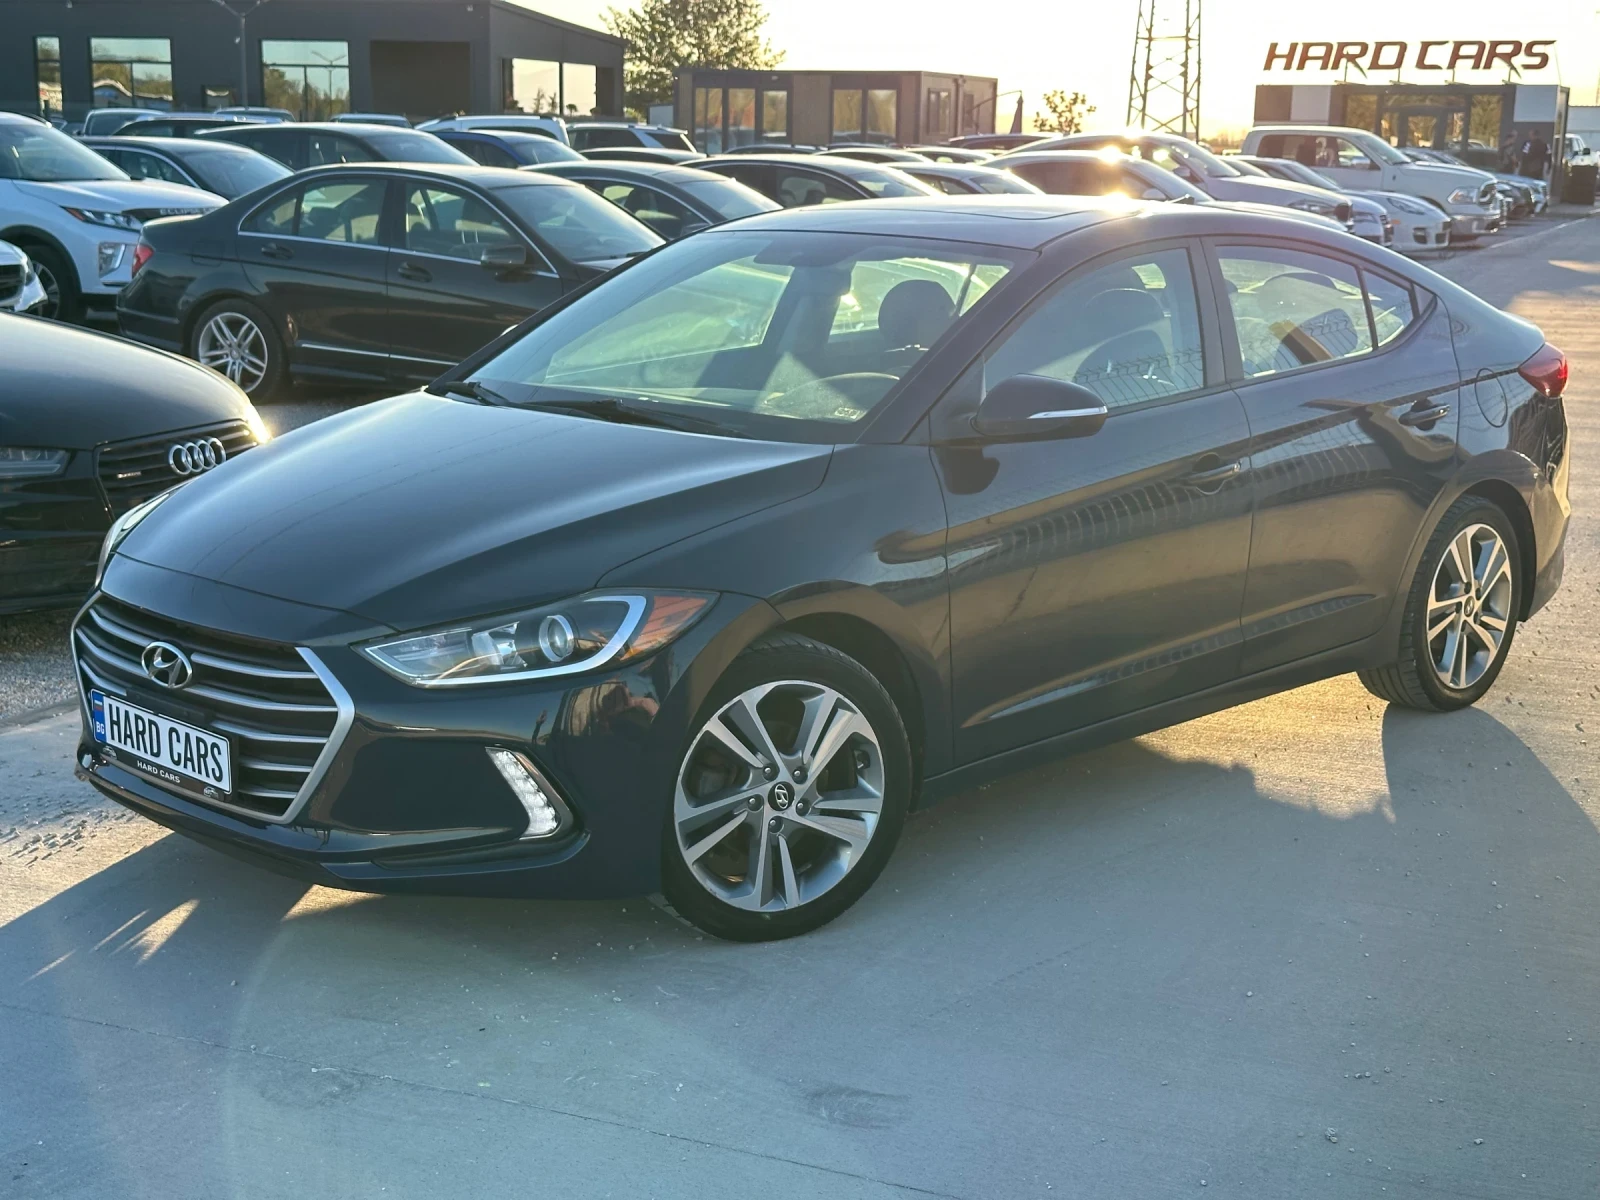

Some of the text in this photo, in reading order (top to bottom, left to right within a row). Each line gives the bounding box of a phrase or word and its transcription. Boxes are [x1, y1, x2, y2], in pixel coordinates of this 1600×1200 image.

[1263, 40, 1557, 79] HARD CARS
[96, 721, 105, 735] BG
[108, 703, 223, 783] HARD CARS
[137, 760, 181, 784] HARD CARS
